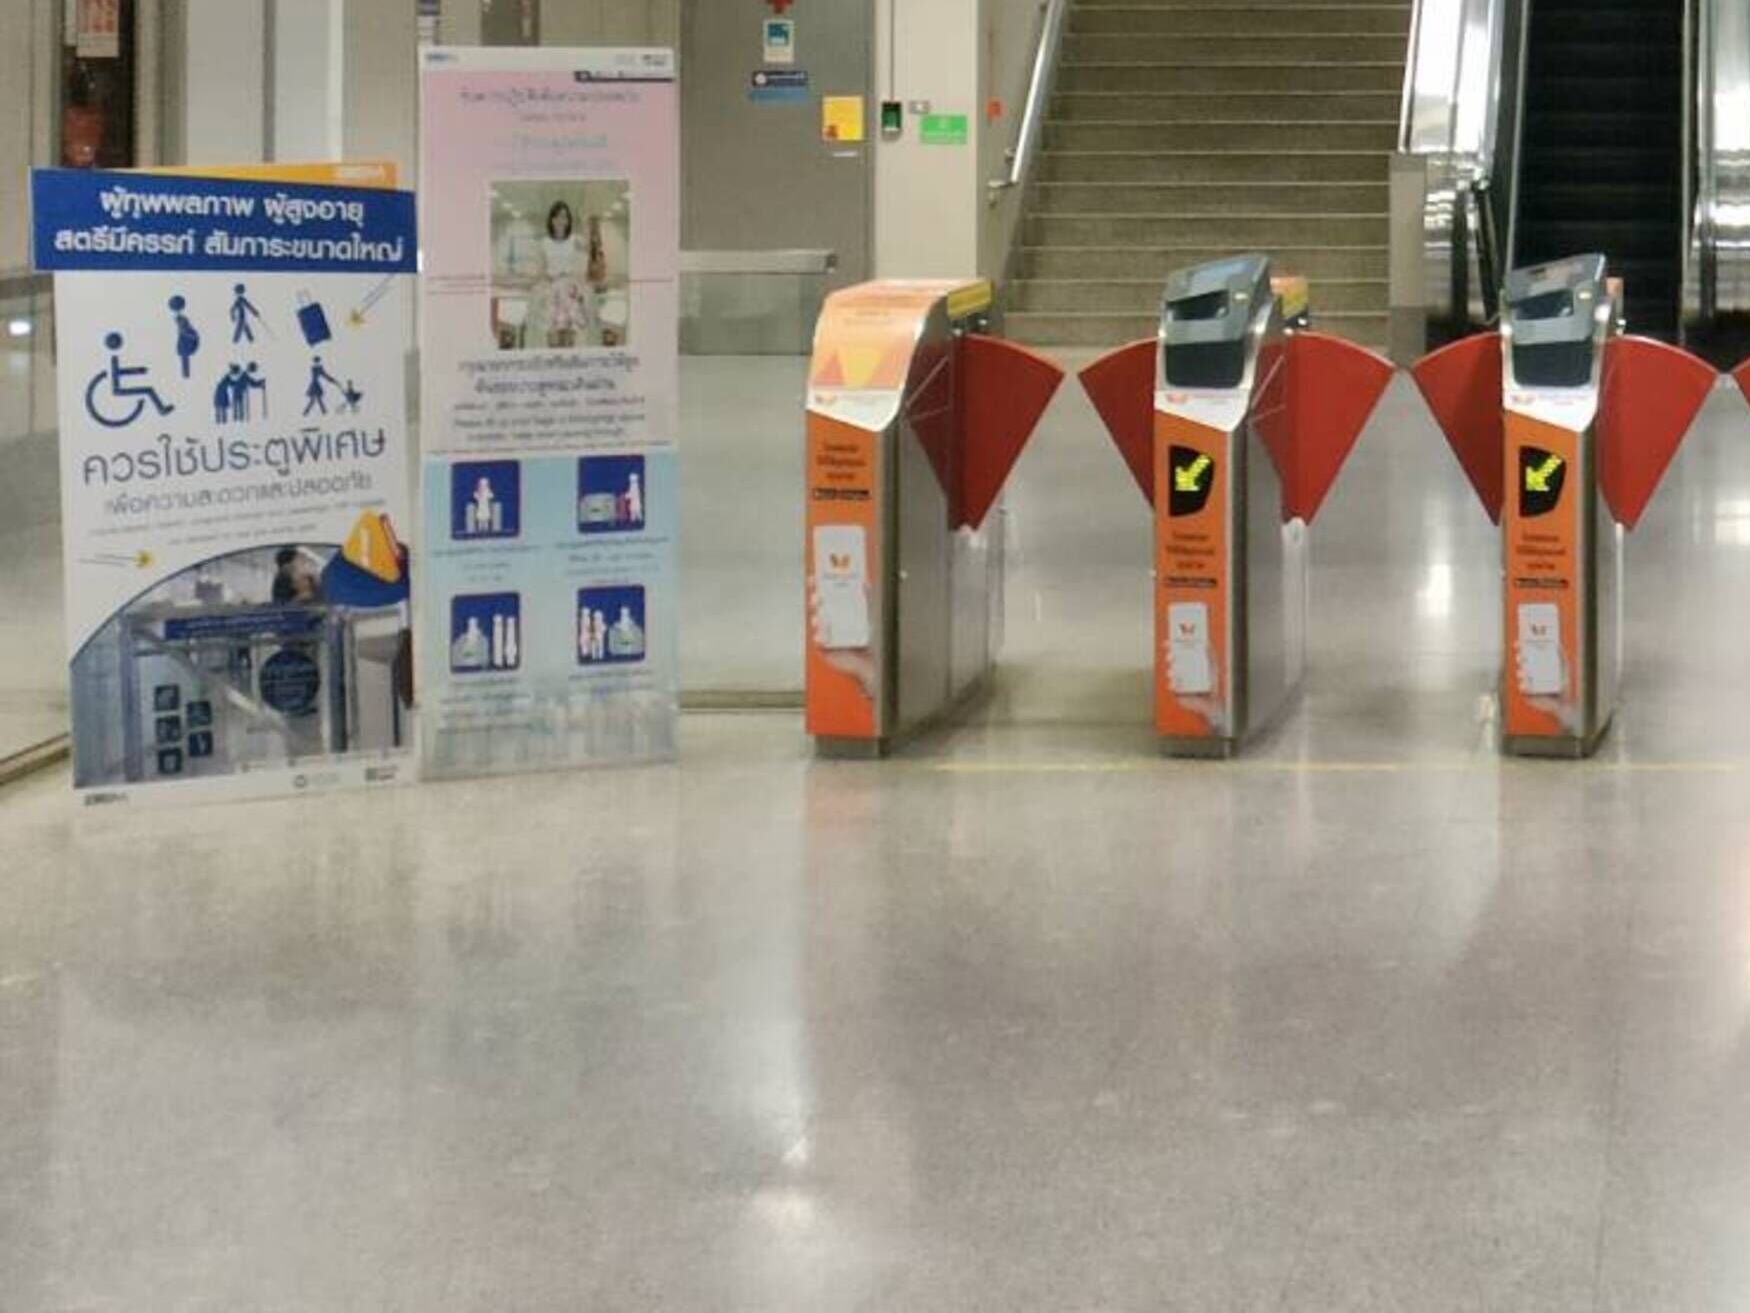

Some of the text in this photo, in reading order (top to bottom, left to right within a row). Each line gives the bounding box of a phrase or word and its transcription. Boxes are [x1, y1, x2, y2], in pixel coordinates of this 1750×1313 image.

[263, 192, 365, 228] ผู้สูงอายุ
[82, 427, 388, 485] ควรใช้ประตูพิเศษ
